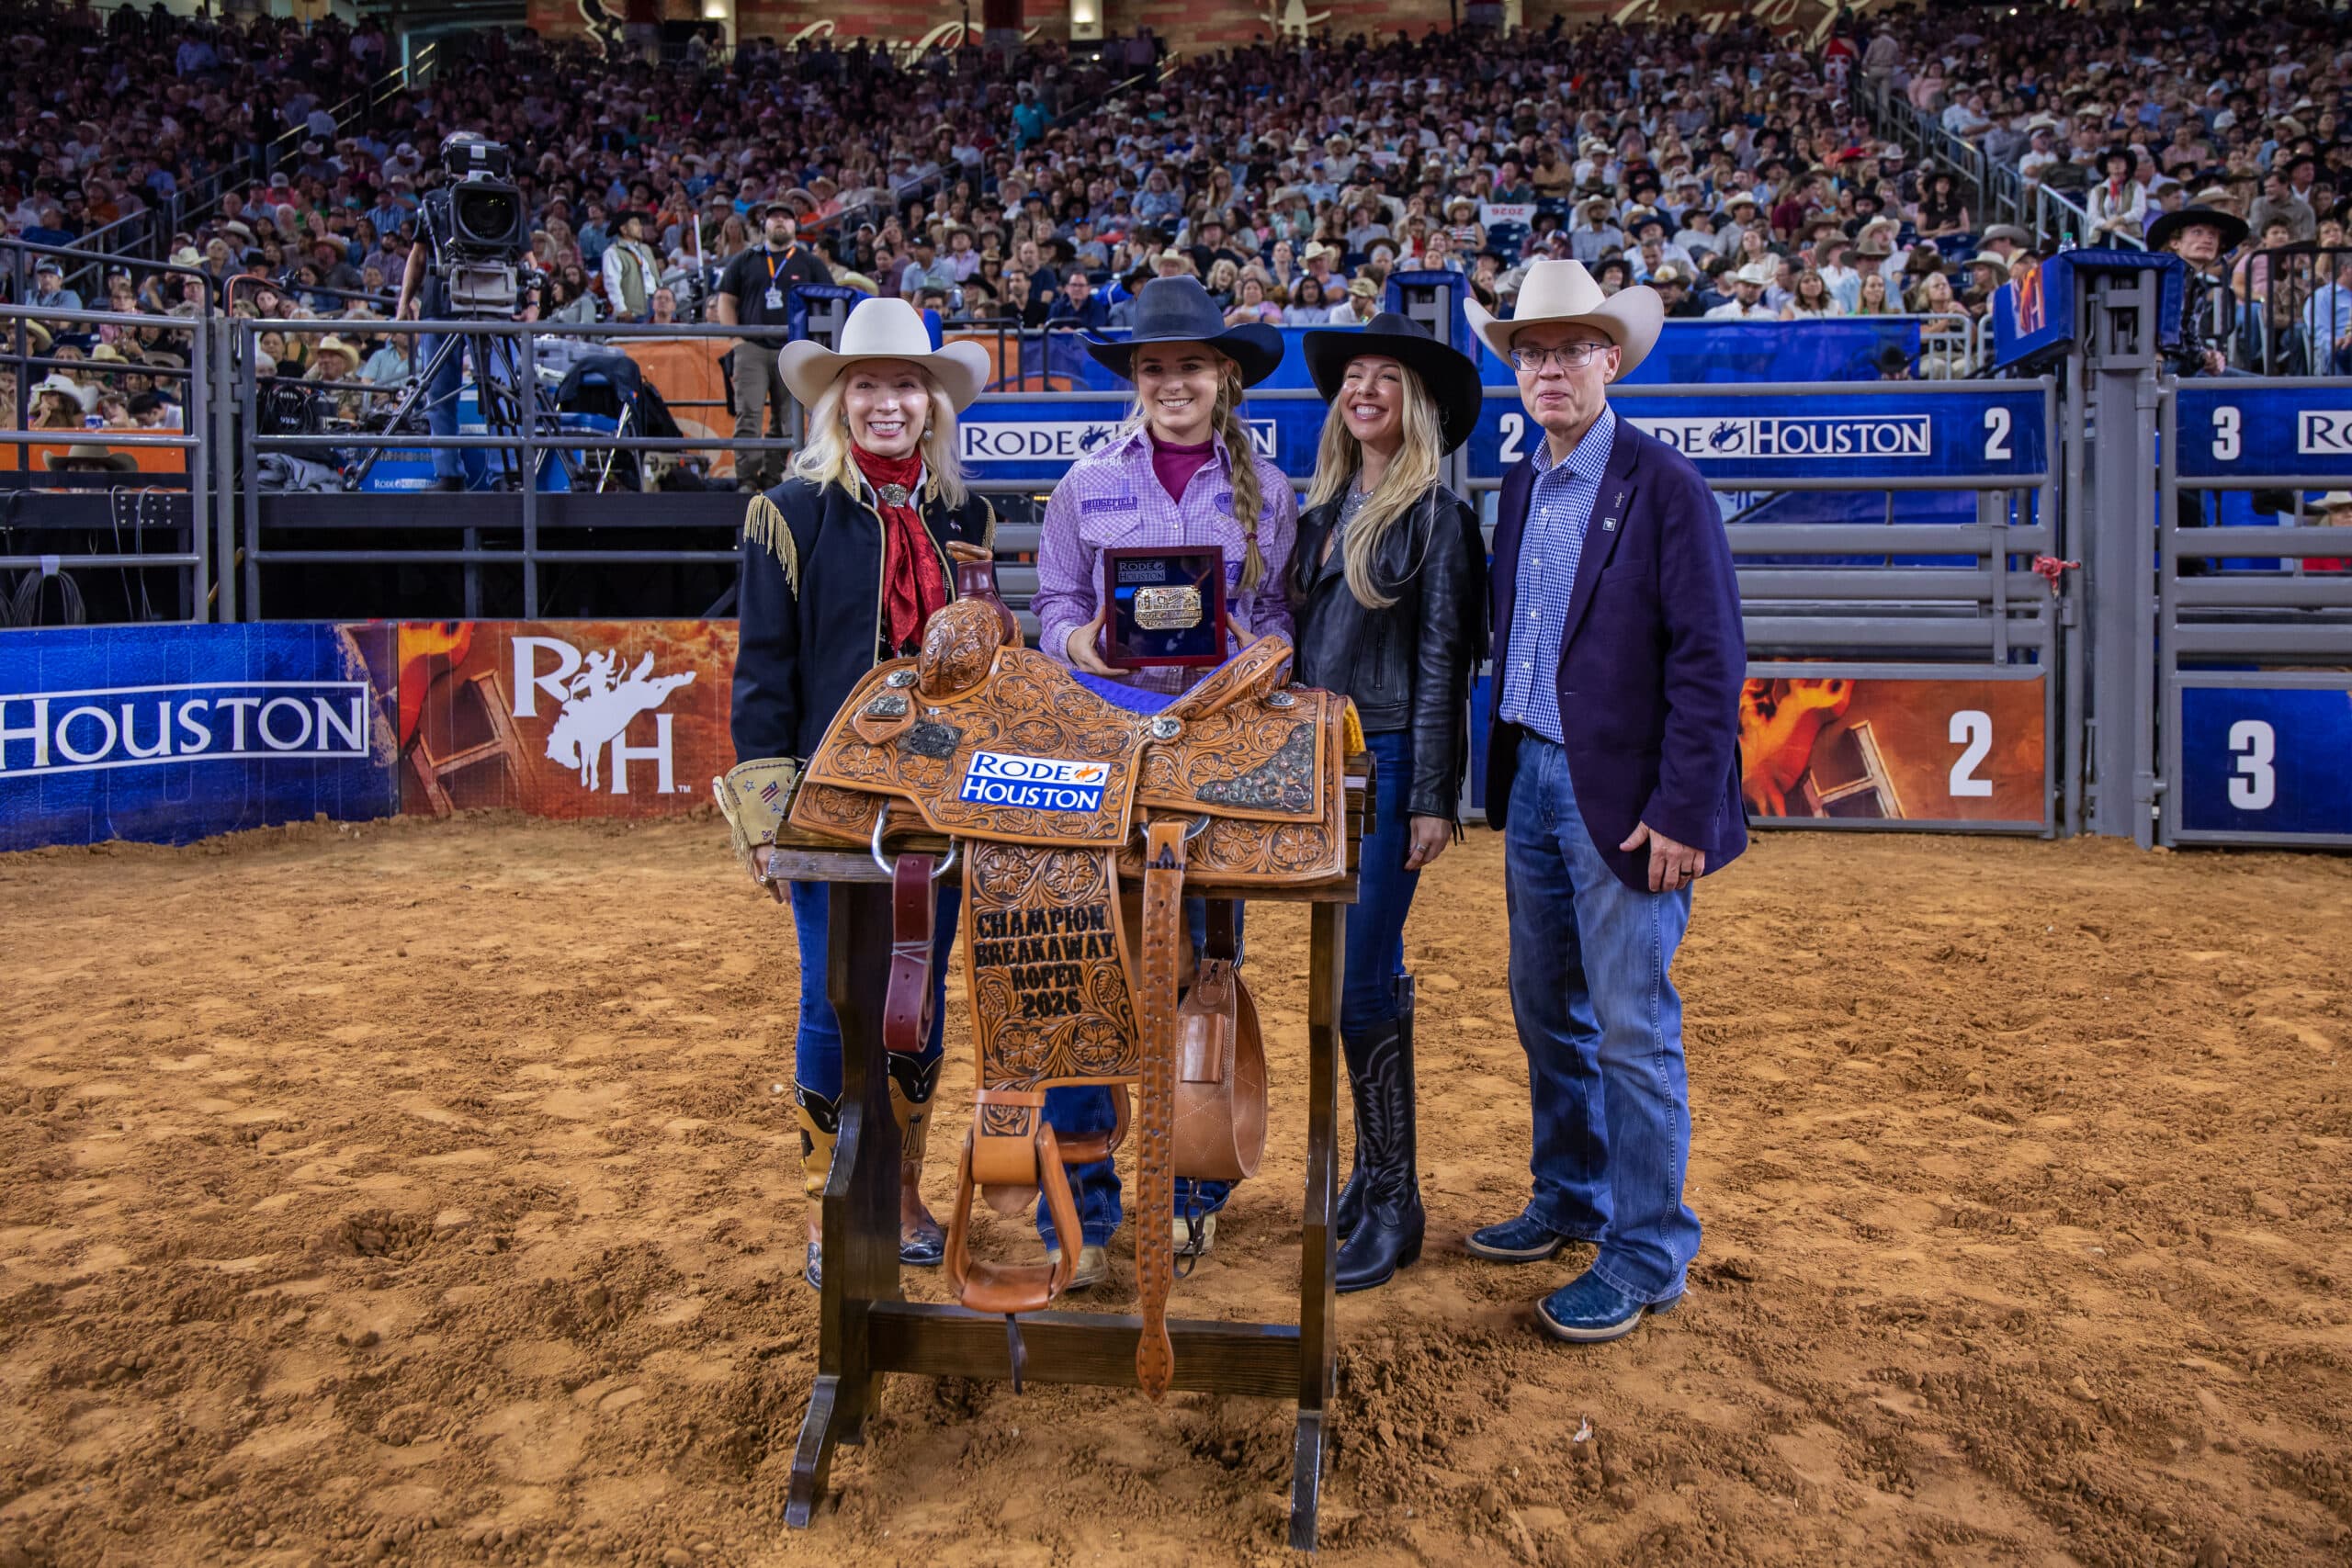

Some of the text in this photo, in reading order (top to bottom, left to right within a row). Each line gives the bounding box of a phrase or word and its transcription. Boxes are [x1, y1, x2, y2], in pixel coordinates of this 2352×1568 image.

[1499, 412, 1525, 463] 2
[1654, 420, 1927, 456] DEO HOUSTON
[1984, 407, 2011, 460] 2
[2212, 405, 2241, 461] 3
[1081, 497, 1137, 509] BRIDGEFIELD
[1119, 561, 1164, 570] RODEO
[1119, 571, 1164, 581] HOUSTON
[511, 637, 582, 716] R
[0, 696, 363, 770] HOUSTON
[611, 714, 675, 794] H
[972, 753, 1103, 783] RODEO
[1949, 710, 1993, 797] 2
[2228, 719, 2276, 810] 3
[961, 777, 1099, 809] HOUSTON
[977, 904, 1105, 939] CHAMPION
[974, 933, 1114, 970] BREAKAWAY
[1012, 964, 1083, 991] ROPER
[1021, 987, 1082, 1019] 2026
